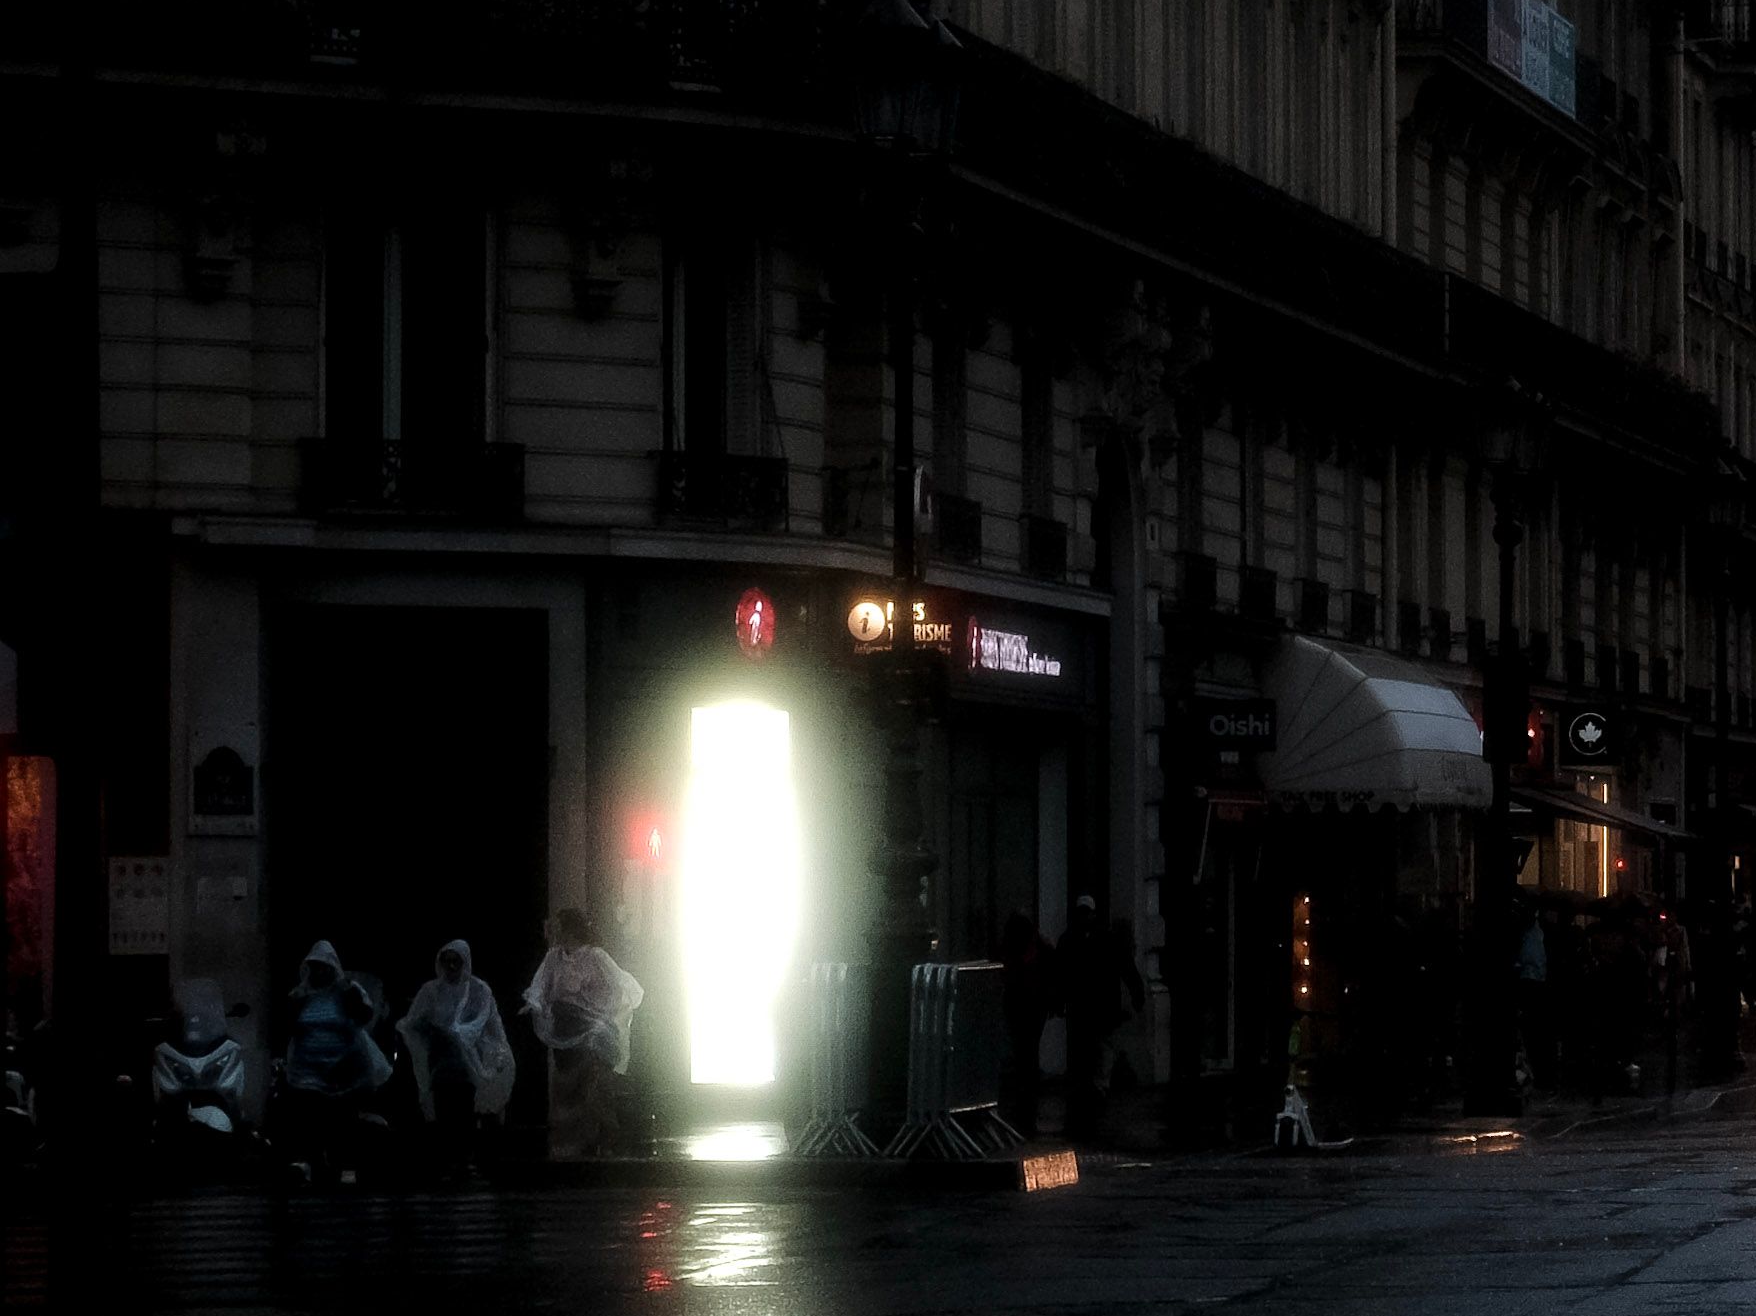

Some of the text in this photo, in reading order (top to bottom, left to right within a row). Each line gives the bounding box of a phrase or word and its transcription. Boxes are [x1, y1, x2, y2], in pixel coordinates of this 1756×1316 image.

[886, 623, 952, 642] TRISME
[1209, 712, 1271, 737] Oishi
[1281, 789, 1376, 803] TAX FREE SHOP
